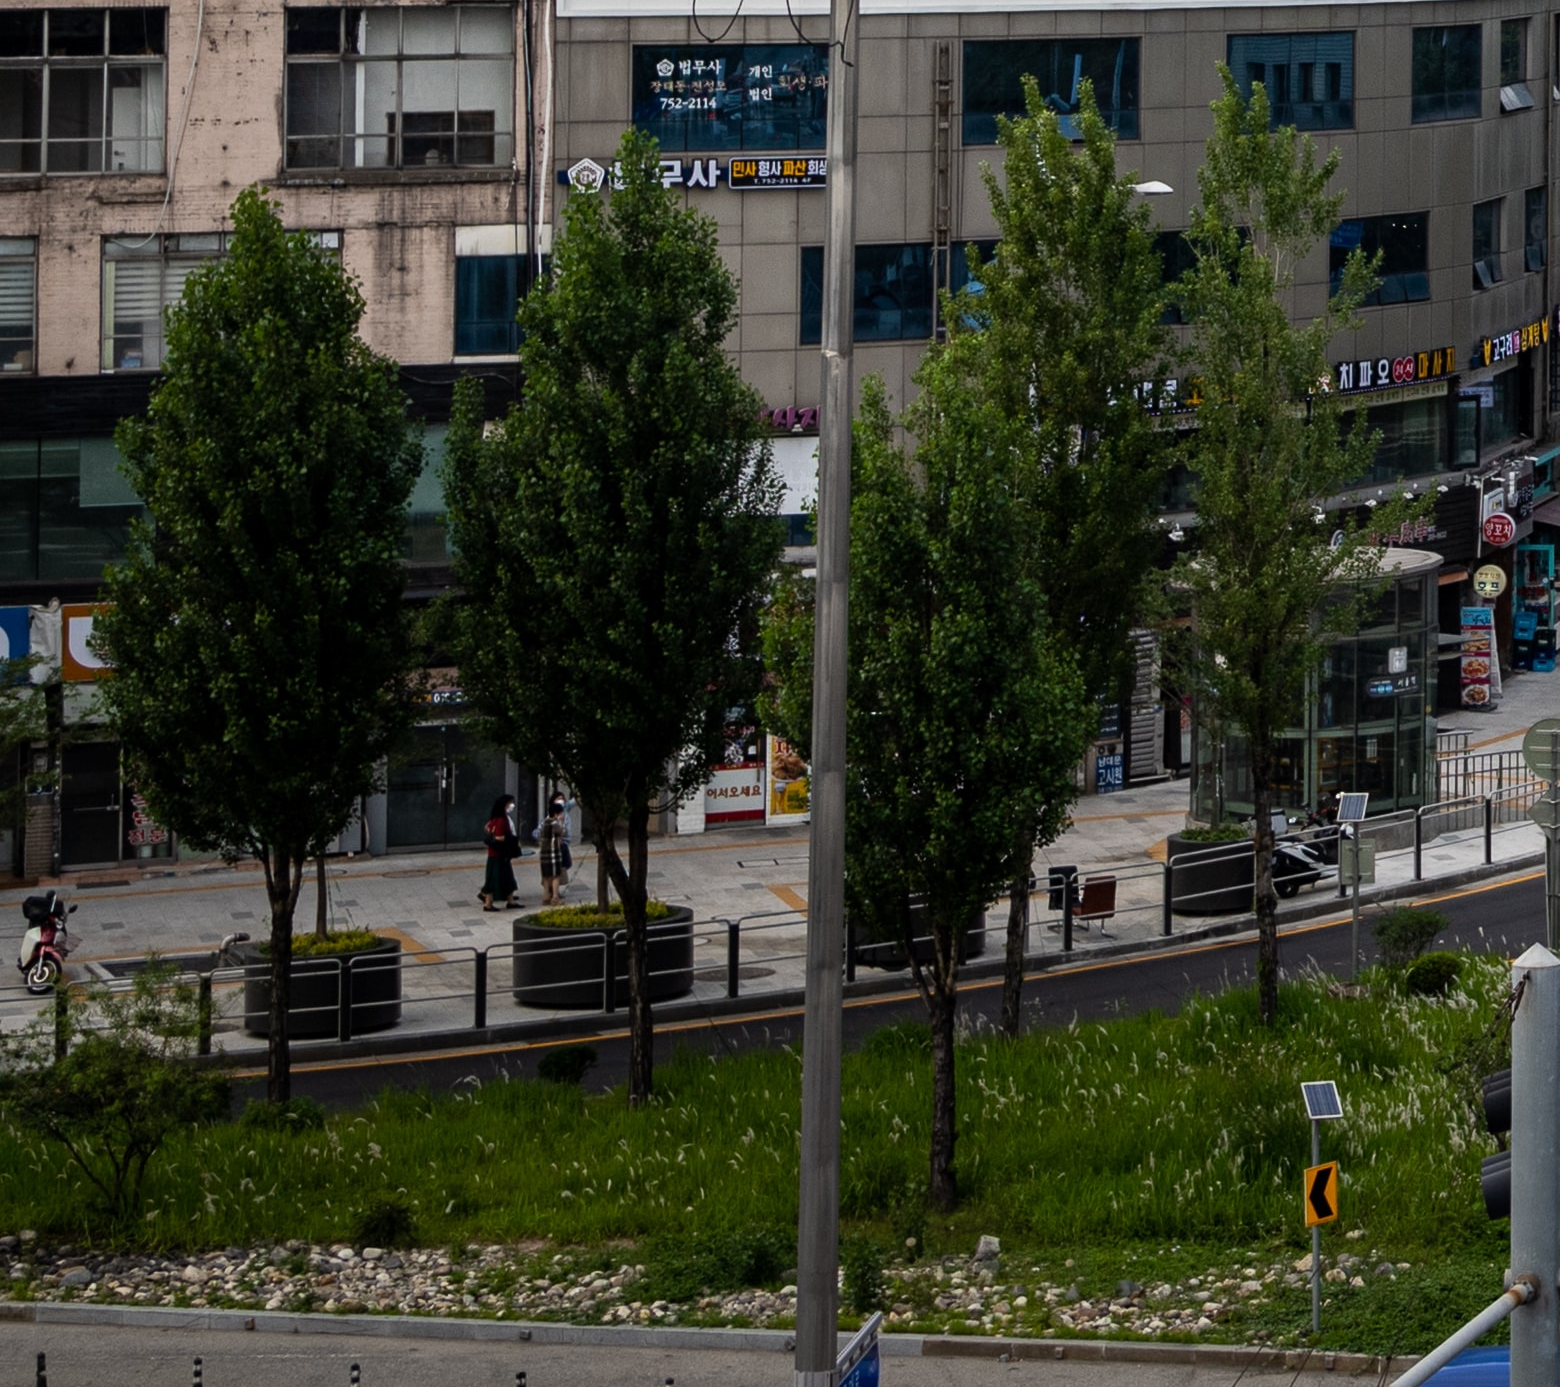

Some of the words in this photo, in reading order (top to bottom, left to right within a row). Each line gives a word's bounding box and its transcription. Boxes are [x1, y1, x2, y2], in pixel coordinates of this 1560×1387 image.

[678, 59, 722, 76] 법무사
[748, 64, 774, 79] 개인
[748, 87, 774, 102] 법인
[660, 97, 718, 109] 752-2114
[732, 160, 757, 178] 민사
[758, 159, 782, 177] 형사
[783, 158, 807, 176] 파산
[1339, 357, 1391, 390] 치파오
[1417, 347, 1457, 379] 마사지
[1096, 755, 1122, 768] 남대문
[1097, 768, 1123, 786] 고시원
[706, 785, 762, 800] 어서오세요
